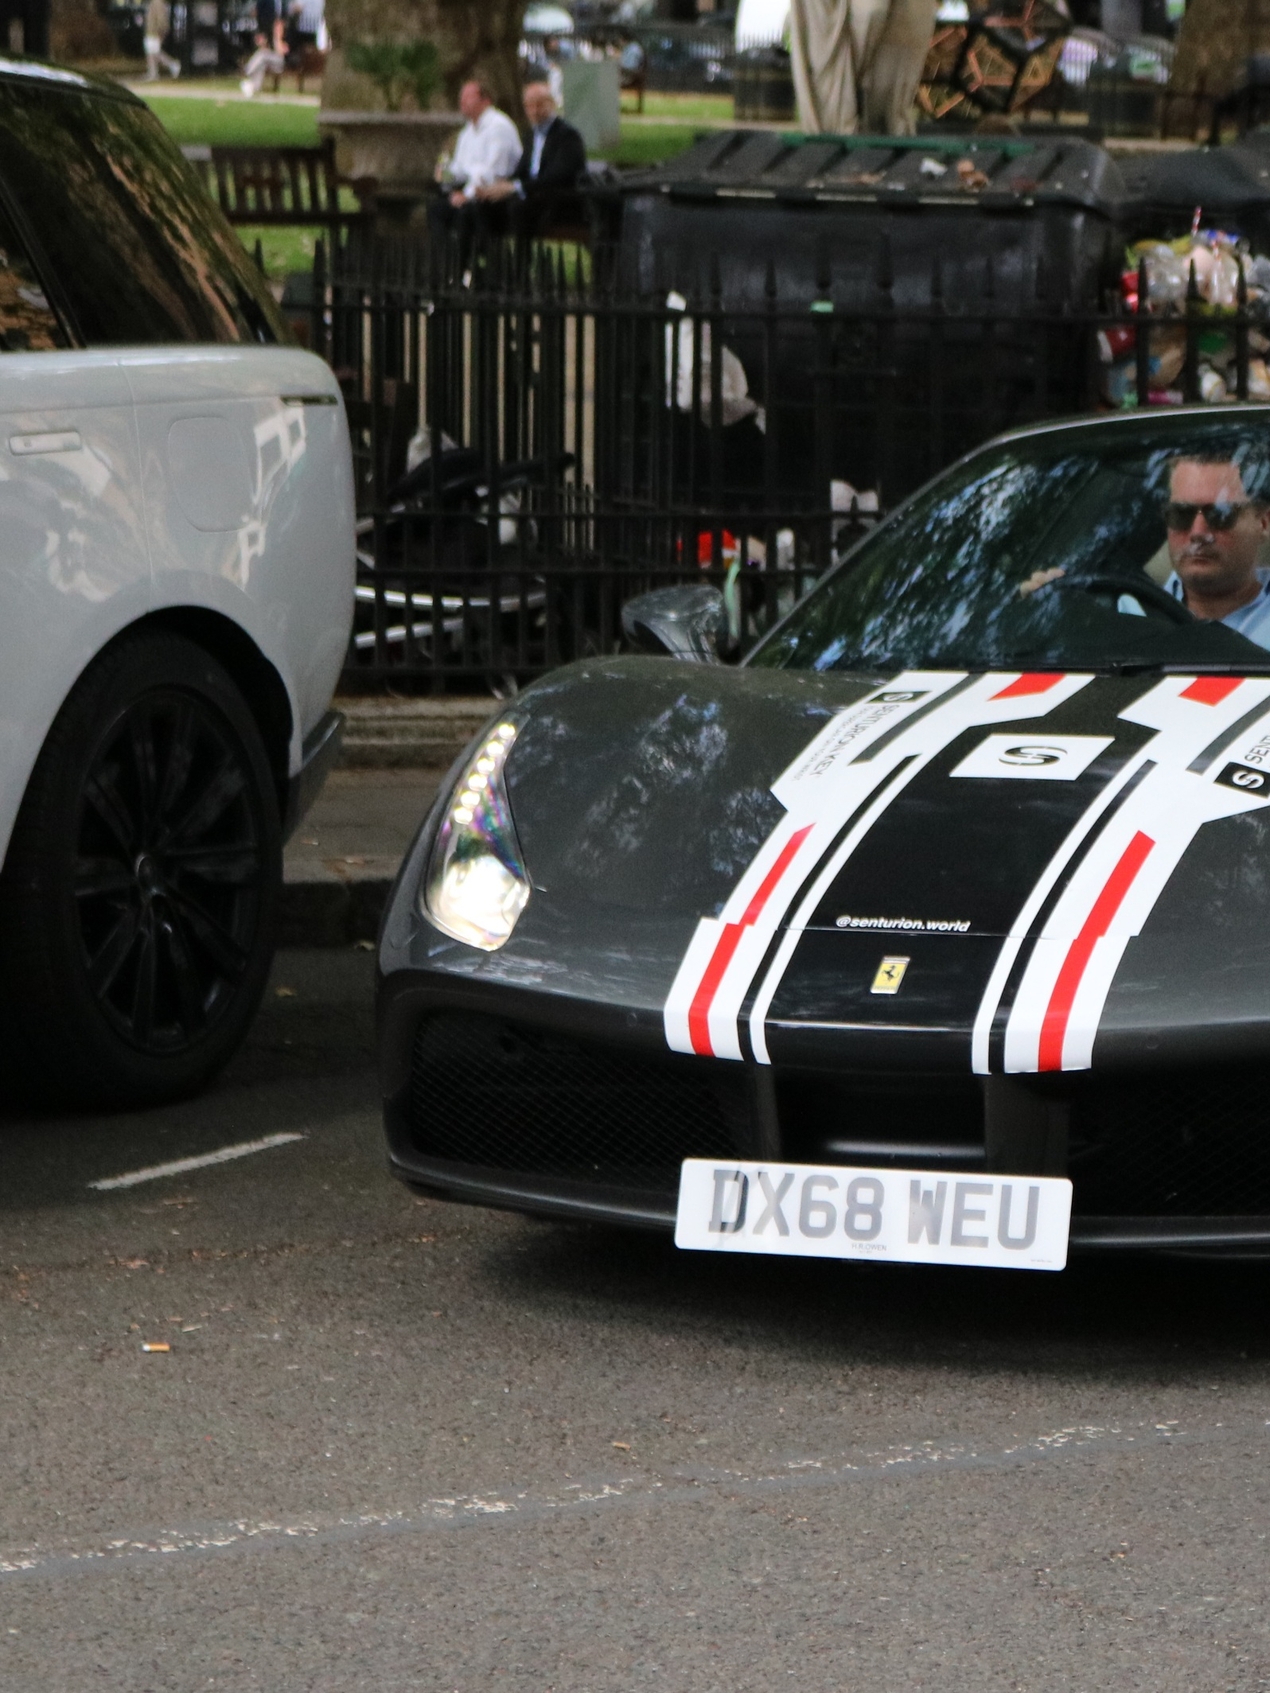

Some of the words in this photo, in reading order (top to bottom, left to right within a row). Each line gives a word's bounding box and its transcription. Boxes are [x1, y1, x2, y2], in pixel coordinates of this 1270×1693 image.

[835, 915, 972, 933] @senturion.world
[708, 1169, 885, 1242] DX68
[907, 1179, 1041, 1251] WEU
